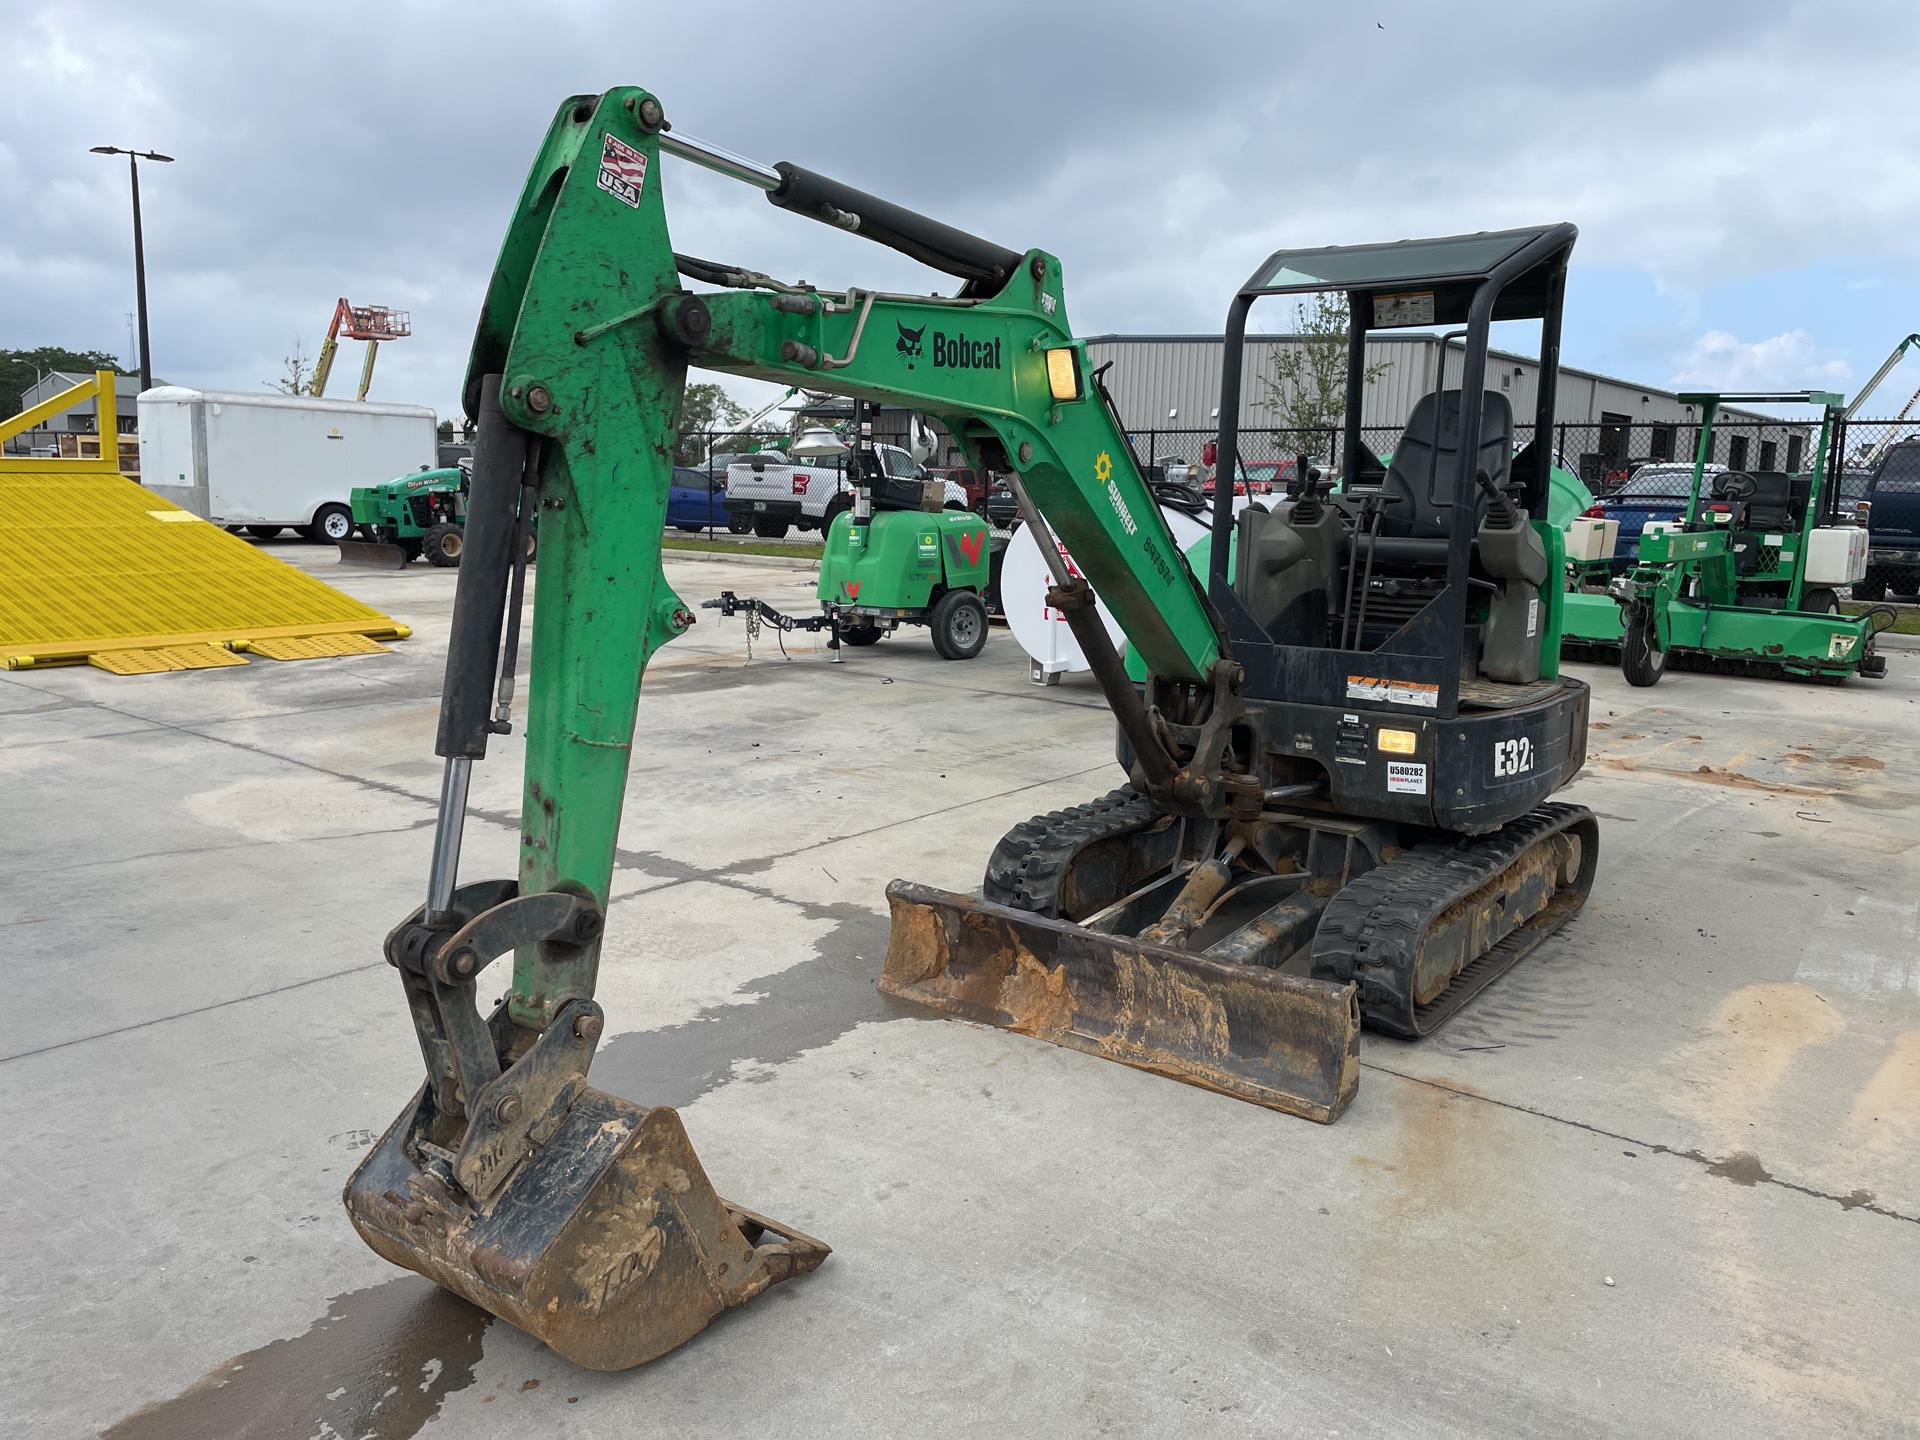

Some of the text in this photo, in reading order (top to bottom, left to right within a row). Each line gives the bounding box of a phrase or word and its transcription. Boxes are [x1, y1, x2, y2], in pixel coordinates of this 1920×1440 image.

[600, 170, 636, 202] USA
[933, 331, 1001, 370] Bobcat
[407, 478, 439, 488] Ditch Witch
[1107, 479, 1138, 536] SUNBELT
[1381, 680, 1410, 688] WRNING
[1389, 765, 1424, 777] U580282
